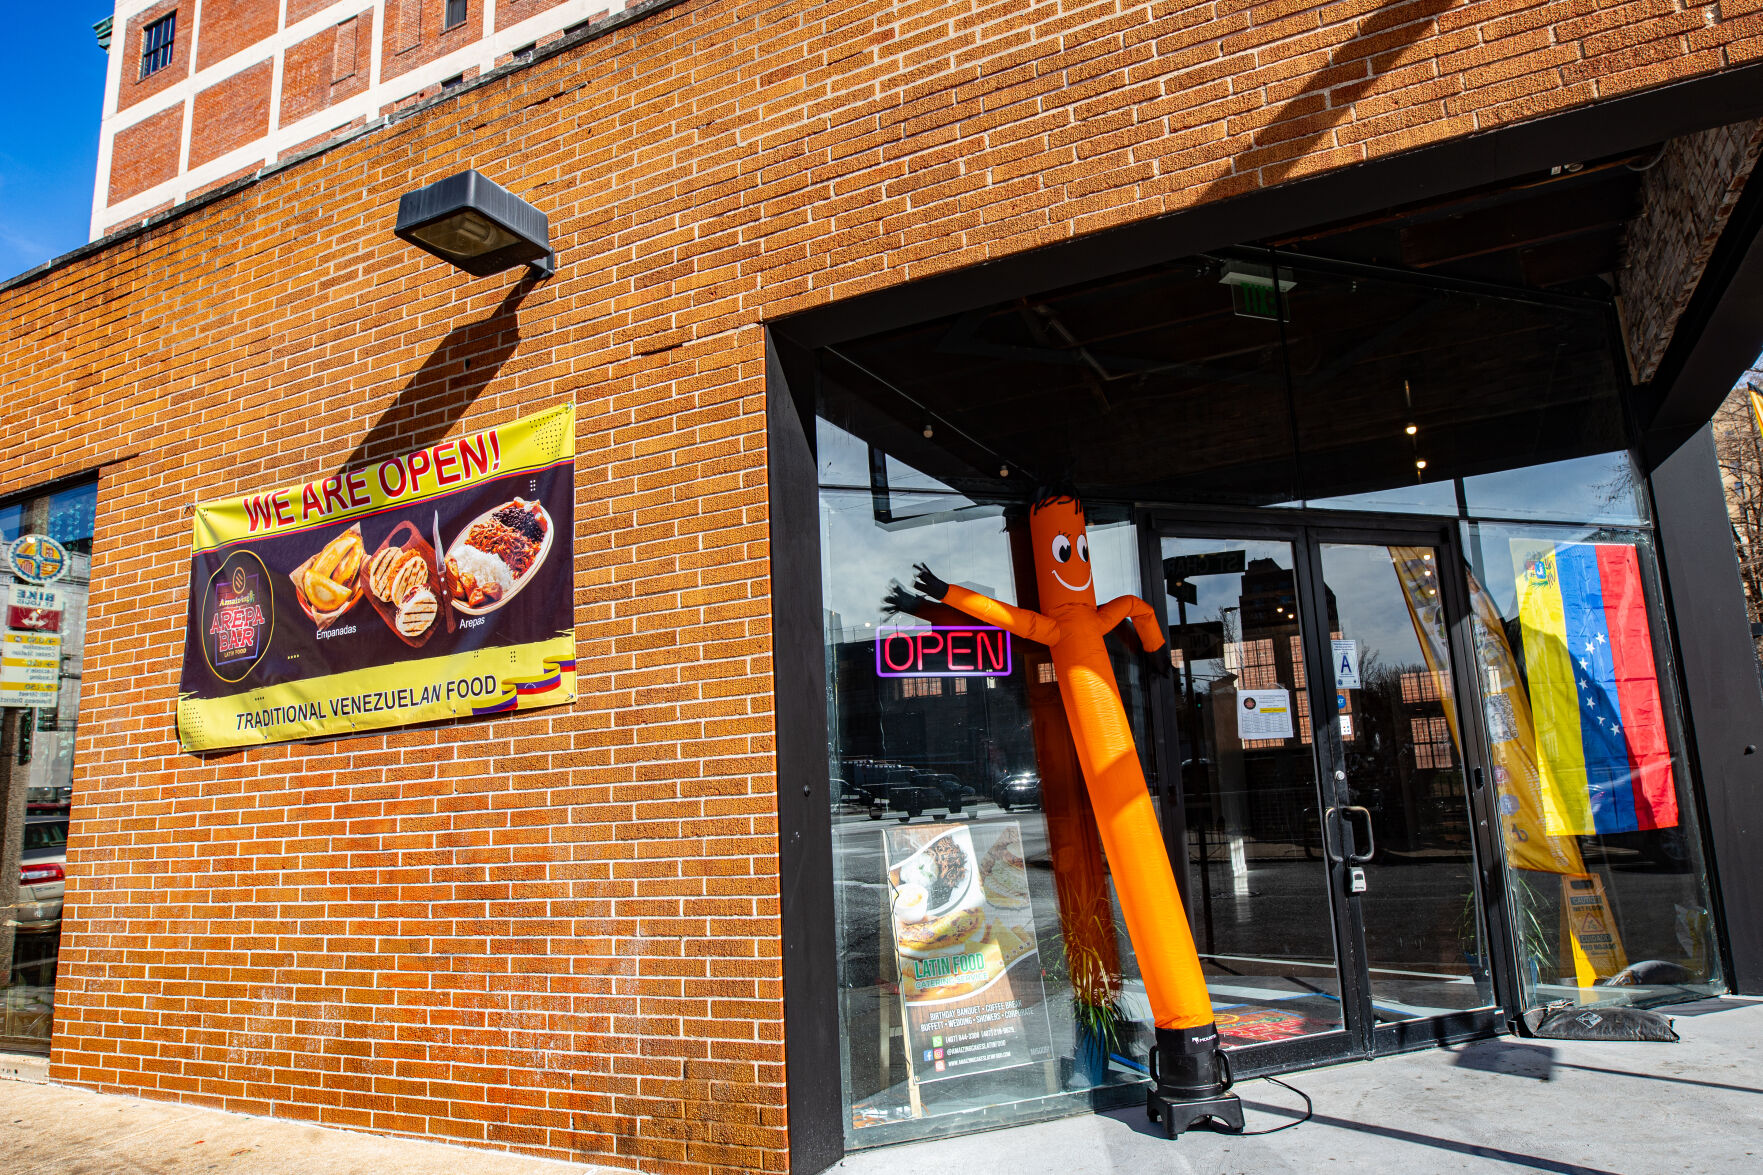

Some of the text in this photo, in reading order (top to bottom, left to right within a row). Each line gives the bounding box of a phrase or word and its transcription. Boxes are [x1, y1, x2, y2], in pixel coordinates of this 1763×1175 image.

[243, 429, 500, 532] WE ARE OPEN!
[210, 604, 265, 634] AREPA
[459, 616, 485, 630] Arepas
[219, 627, 254, 652] BAR
[316, 624, 357, 640] Empanadas
[884, 632, 1004, 671] OPEN
[1340, 655, 1352, 673] A
[236, 674, 497, 731] TRADITIONAL VENEZUELAN FOOD
[913, 952, 985, 980] LATIN FOOD
[915, 972, 989, 989] CATERING SERVICE
[920, 1008, 1034, 1032] BUFFETT WEDDING SHOWERS CORPORATE
[929, 1000, 1023, 1021] BIRTHDAY BANQUET COFFEE BREAK
